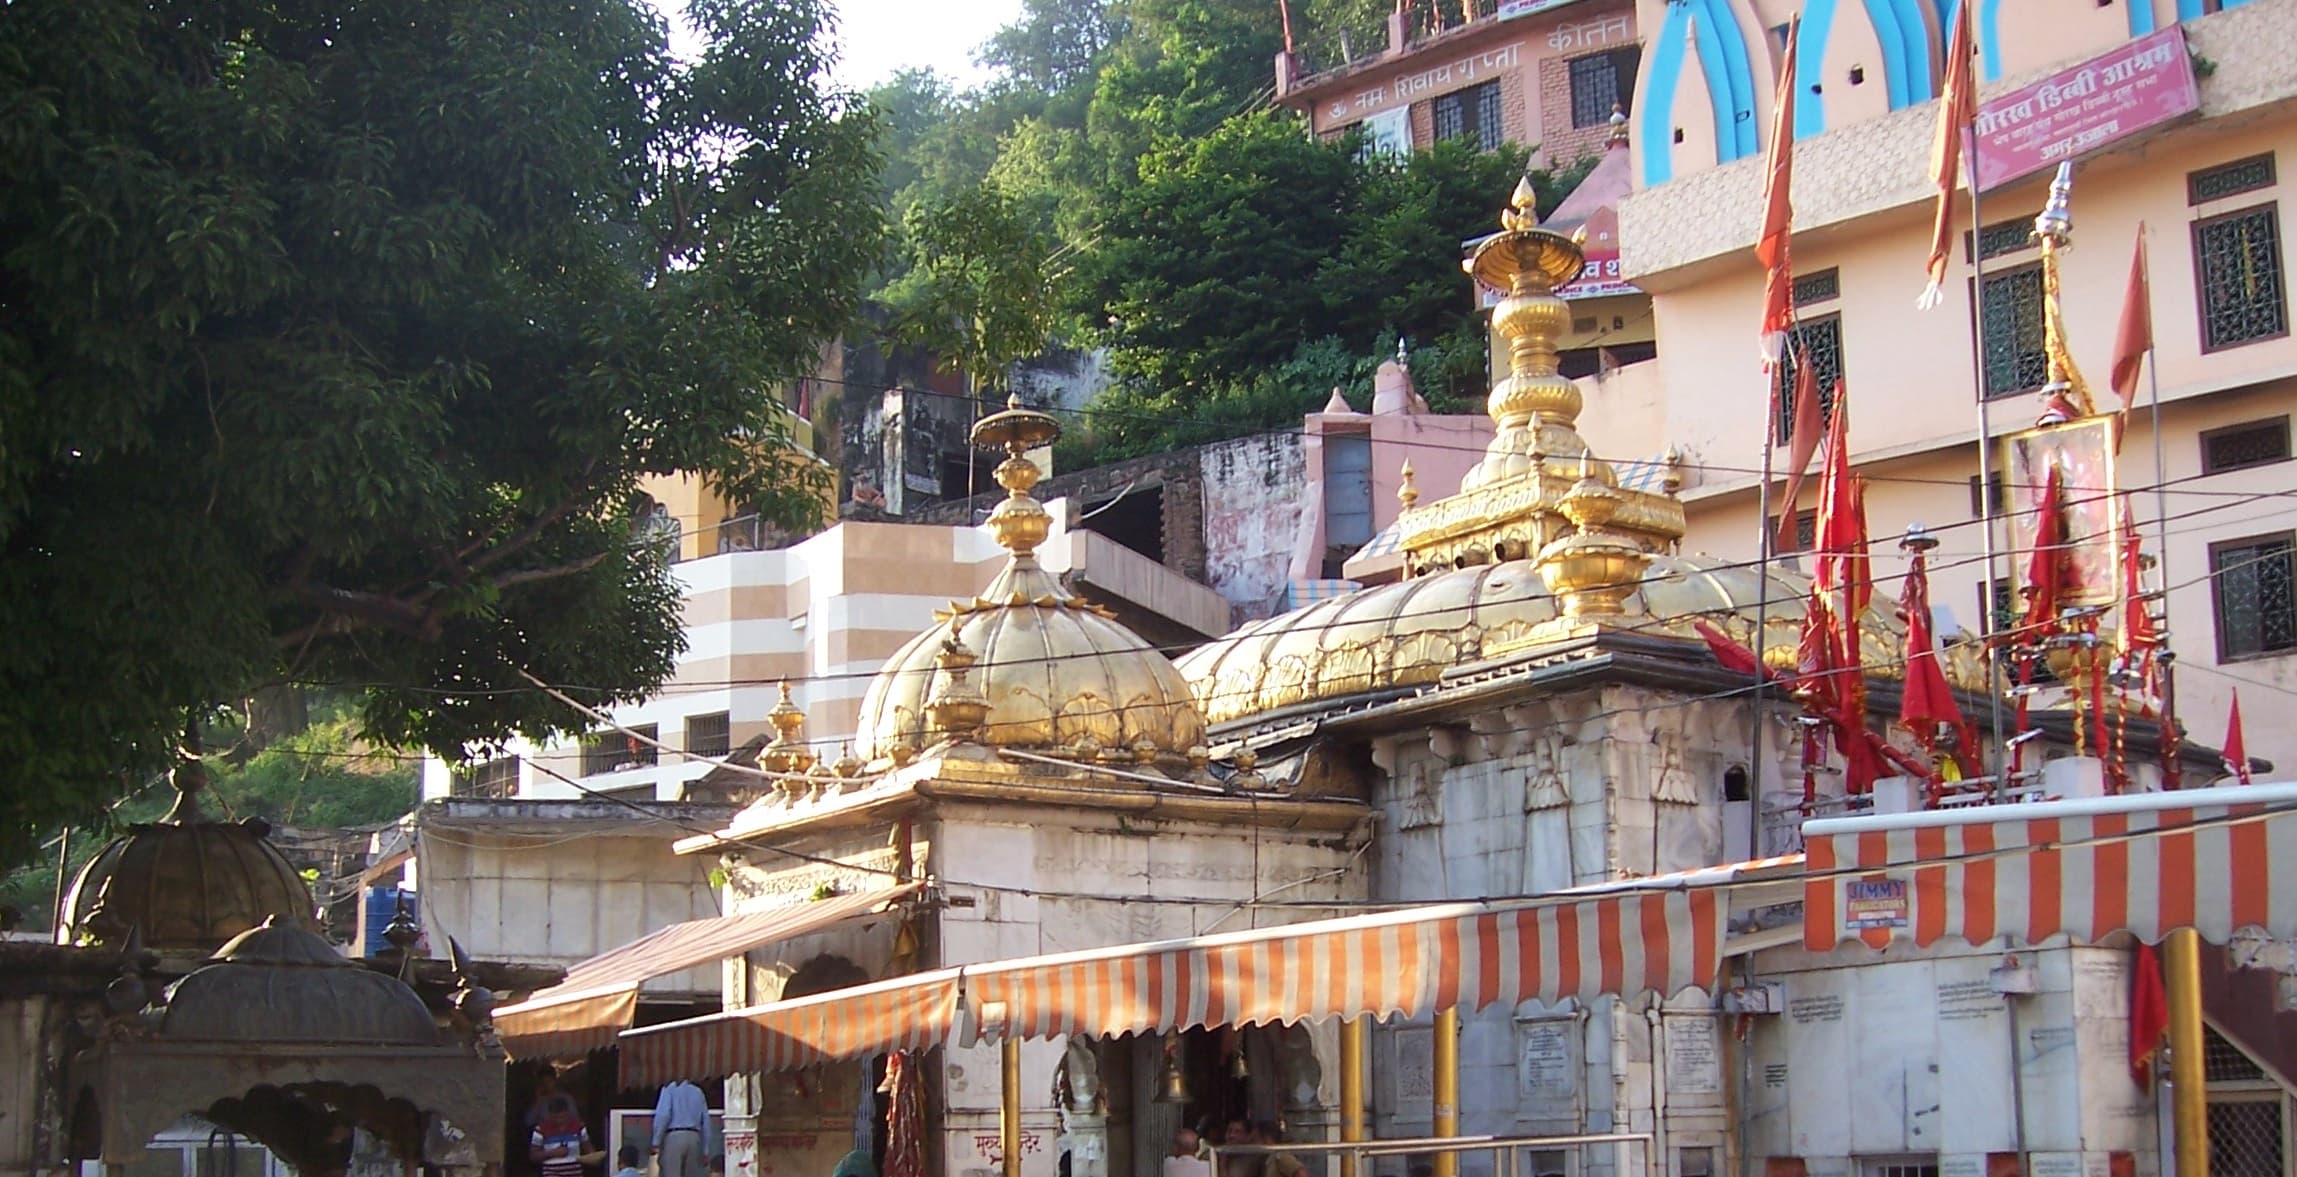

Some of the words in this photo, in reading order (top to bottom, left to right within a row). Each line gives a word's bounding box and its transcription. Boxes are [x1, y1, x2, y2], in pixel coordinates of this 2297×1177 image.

[2101, 41, 2175, 87] आश्रम
[1355, 86, 1387, 110] नमः
[1393, 64, 1452, 101] शिवाय
[2041, 137, 2073, 160] अमर
[2074, 120, 2119, 147] उजाला
[1850, 880, 1904, 899] JIMMY
